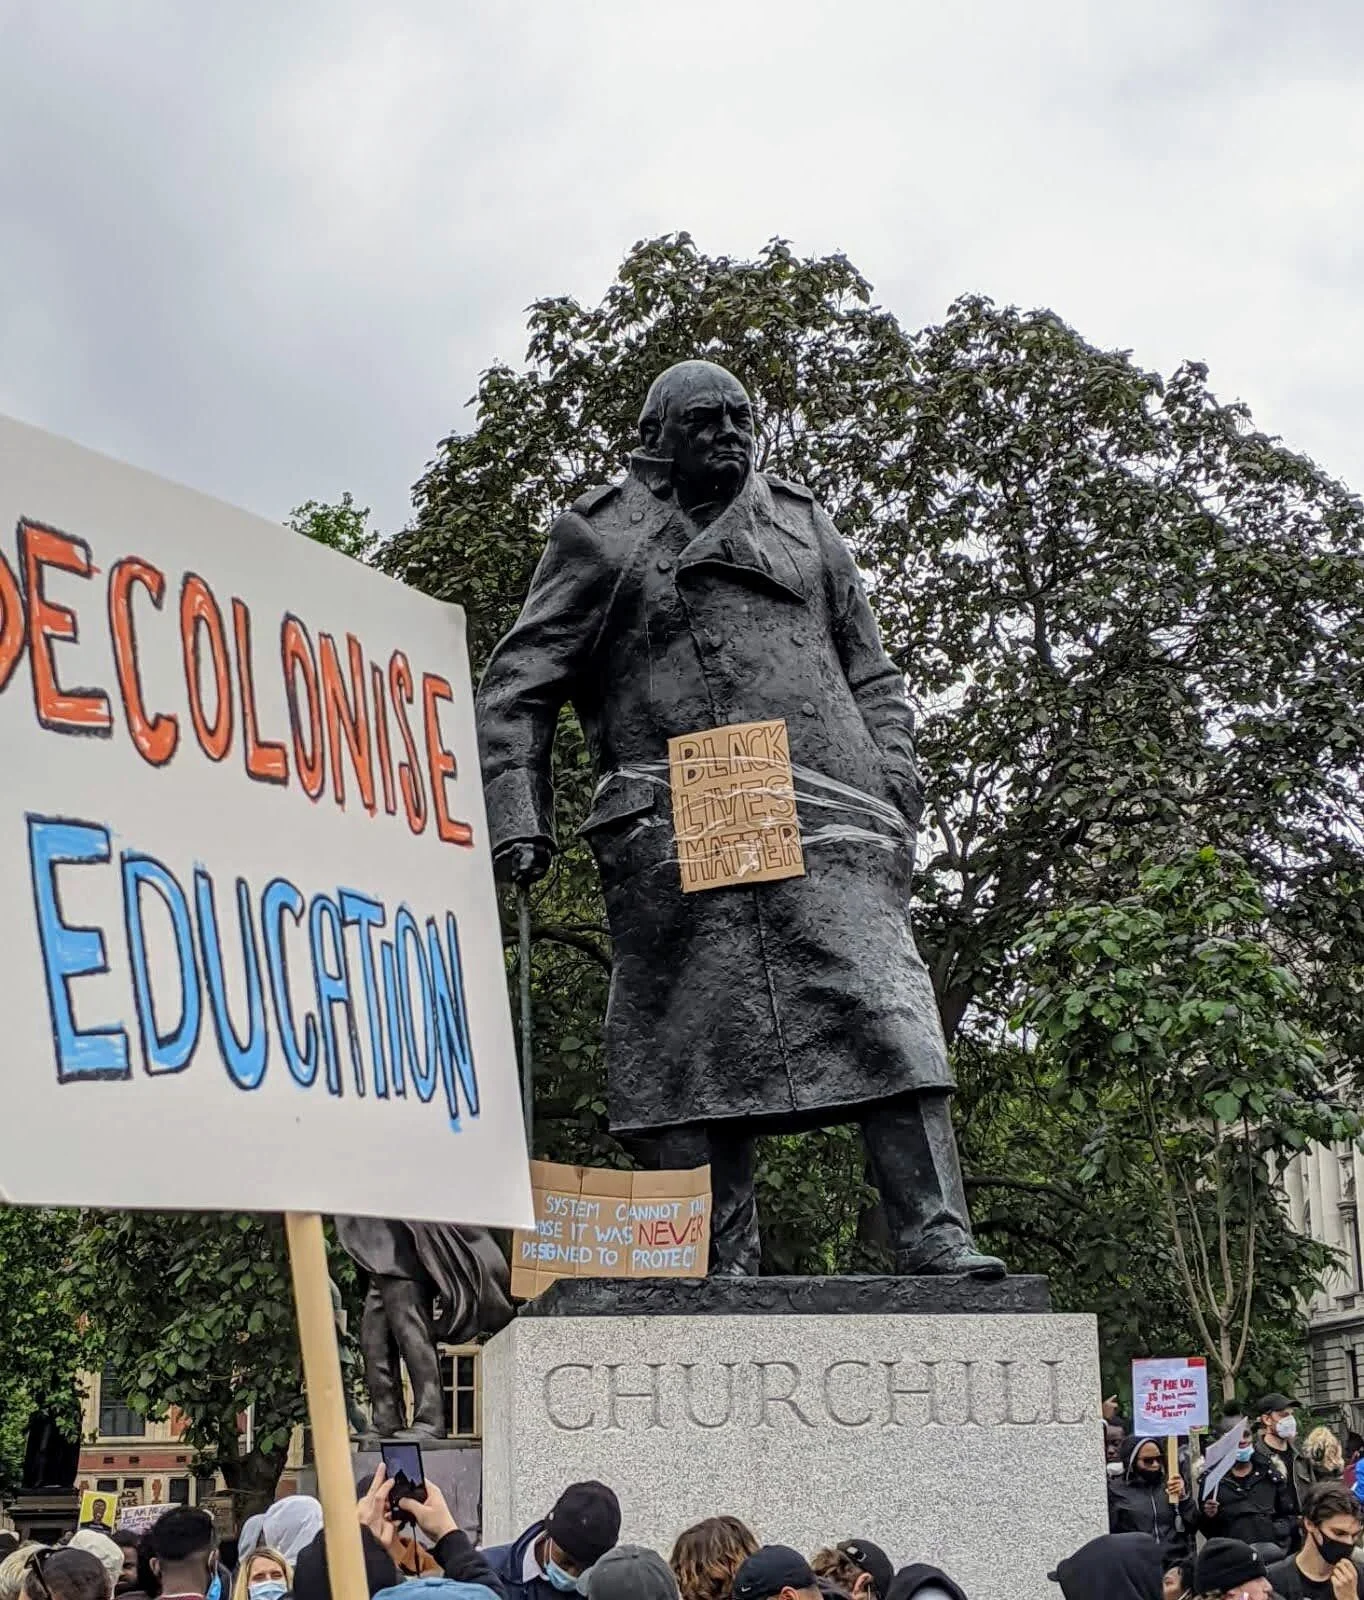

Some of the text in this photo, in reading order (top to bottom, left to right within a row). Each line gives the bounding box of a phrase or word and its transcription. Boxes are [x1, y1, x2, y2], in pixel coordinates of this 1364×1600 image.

[679, 725, 788, 787] BLACK
[680, 775, 795, 835] LIVES
[685, 824, 802, 883] MATTER
[26, 813, 481, 1128] EDUCATION
[545, 1195, 600, 1219] SYSTEM
[616, 1203, 682, 1222] CANNOT
[570, 1222, 589, 1243] IT
[594, 1225, 633, 1246] WAS
[638, 1214, 704, 1246] NEVER
[597, 1246, 619, 1266] TO
[542, 1360, 1087, 1432] CHURCHILL
[1150, 1379, 1178, 1390] THE
